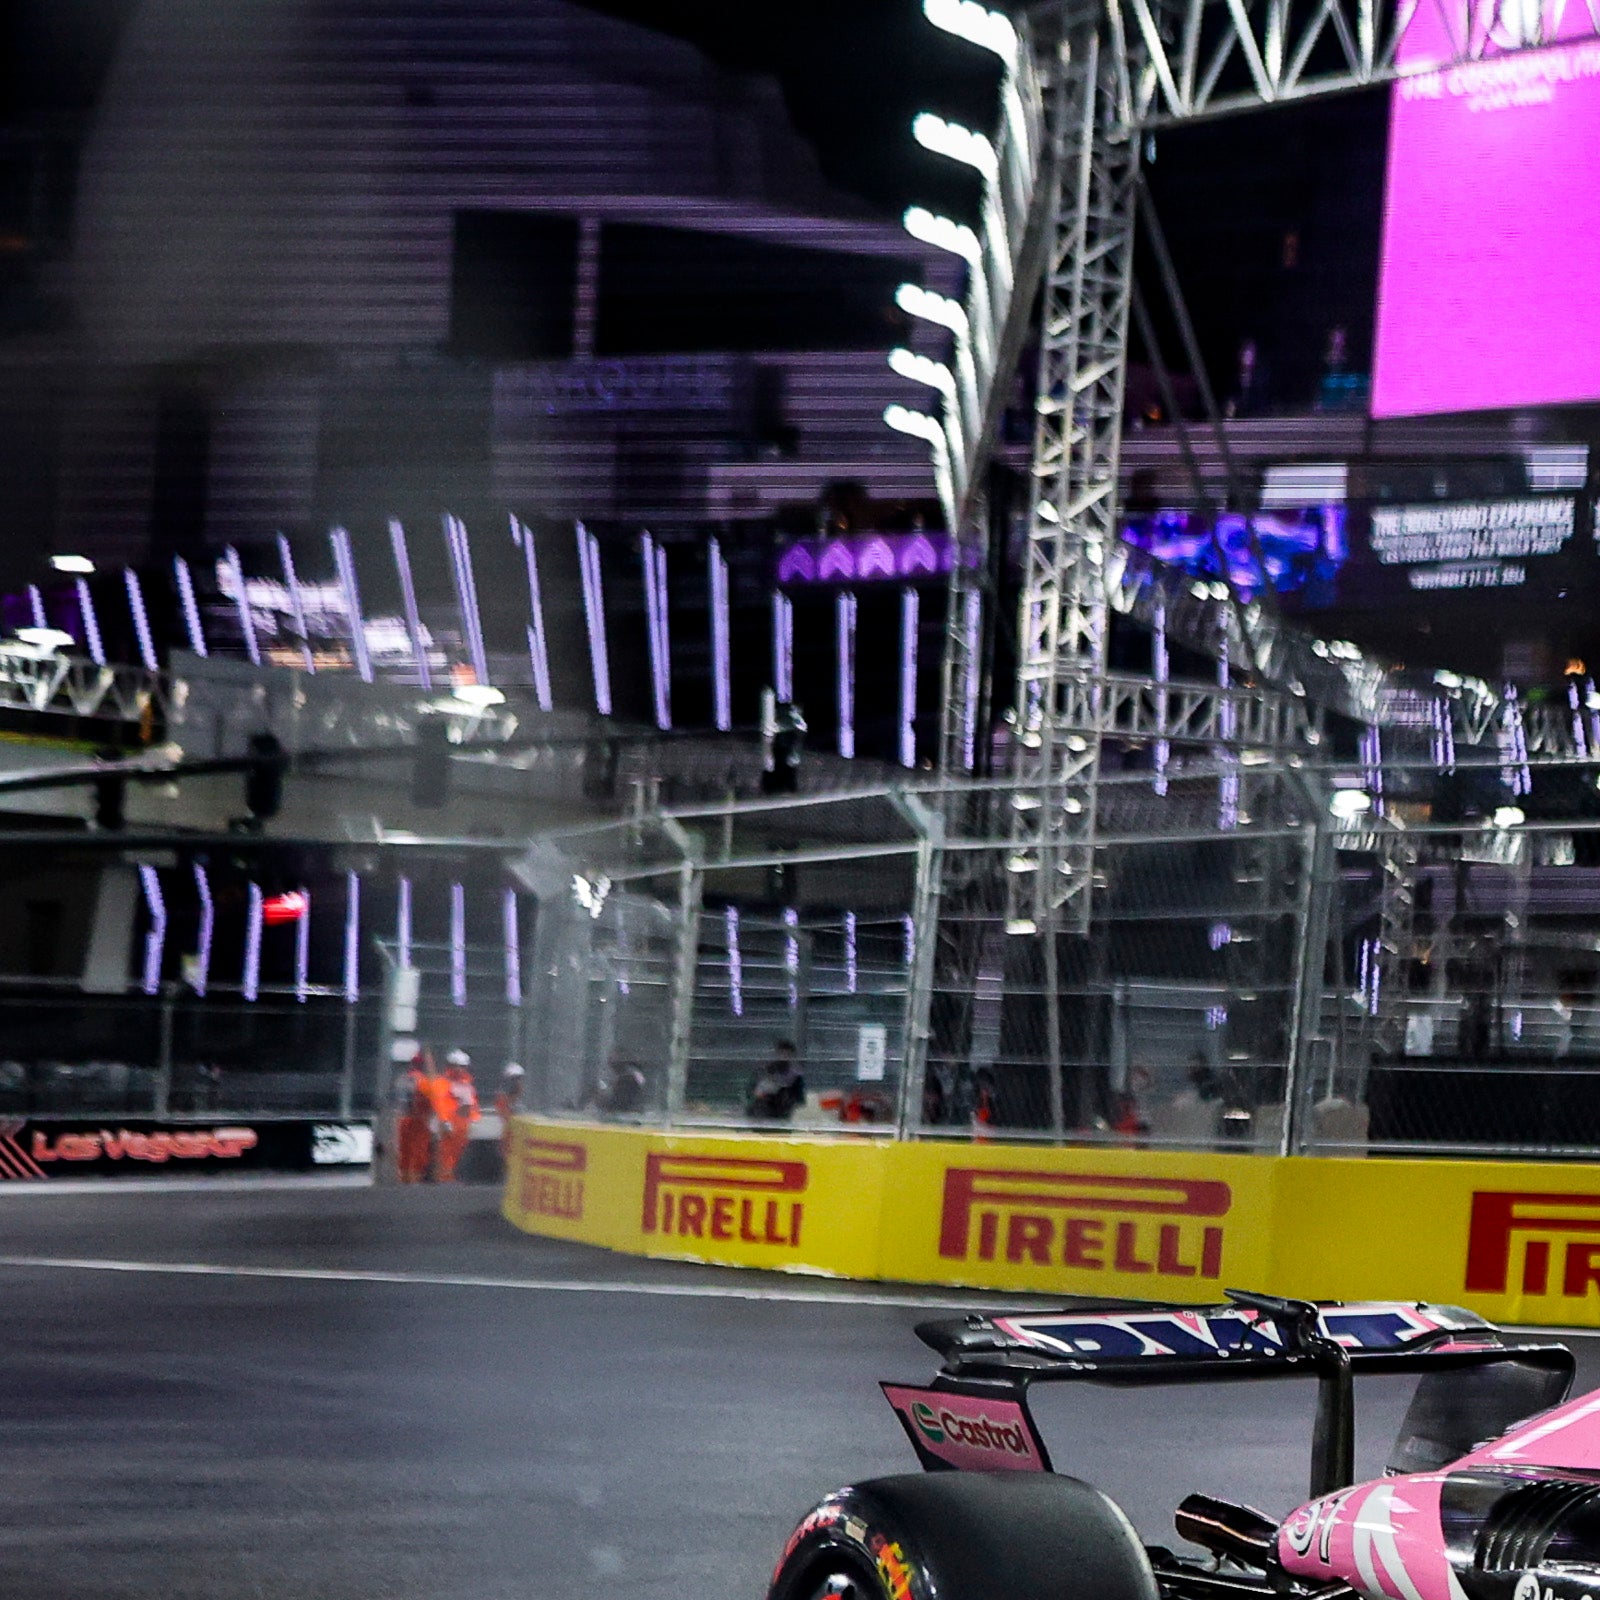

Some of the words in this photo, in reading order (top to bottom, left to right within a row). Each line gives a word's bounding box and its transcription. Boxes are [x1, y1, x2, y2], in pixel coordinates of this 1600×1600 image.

[641, 1151, 808, 1247] PIRELLI
[939, 1167, 1232, 1279] PIRELLI
[938, 1411, 1031, 1455] Castrol
